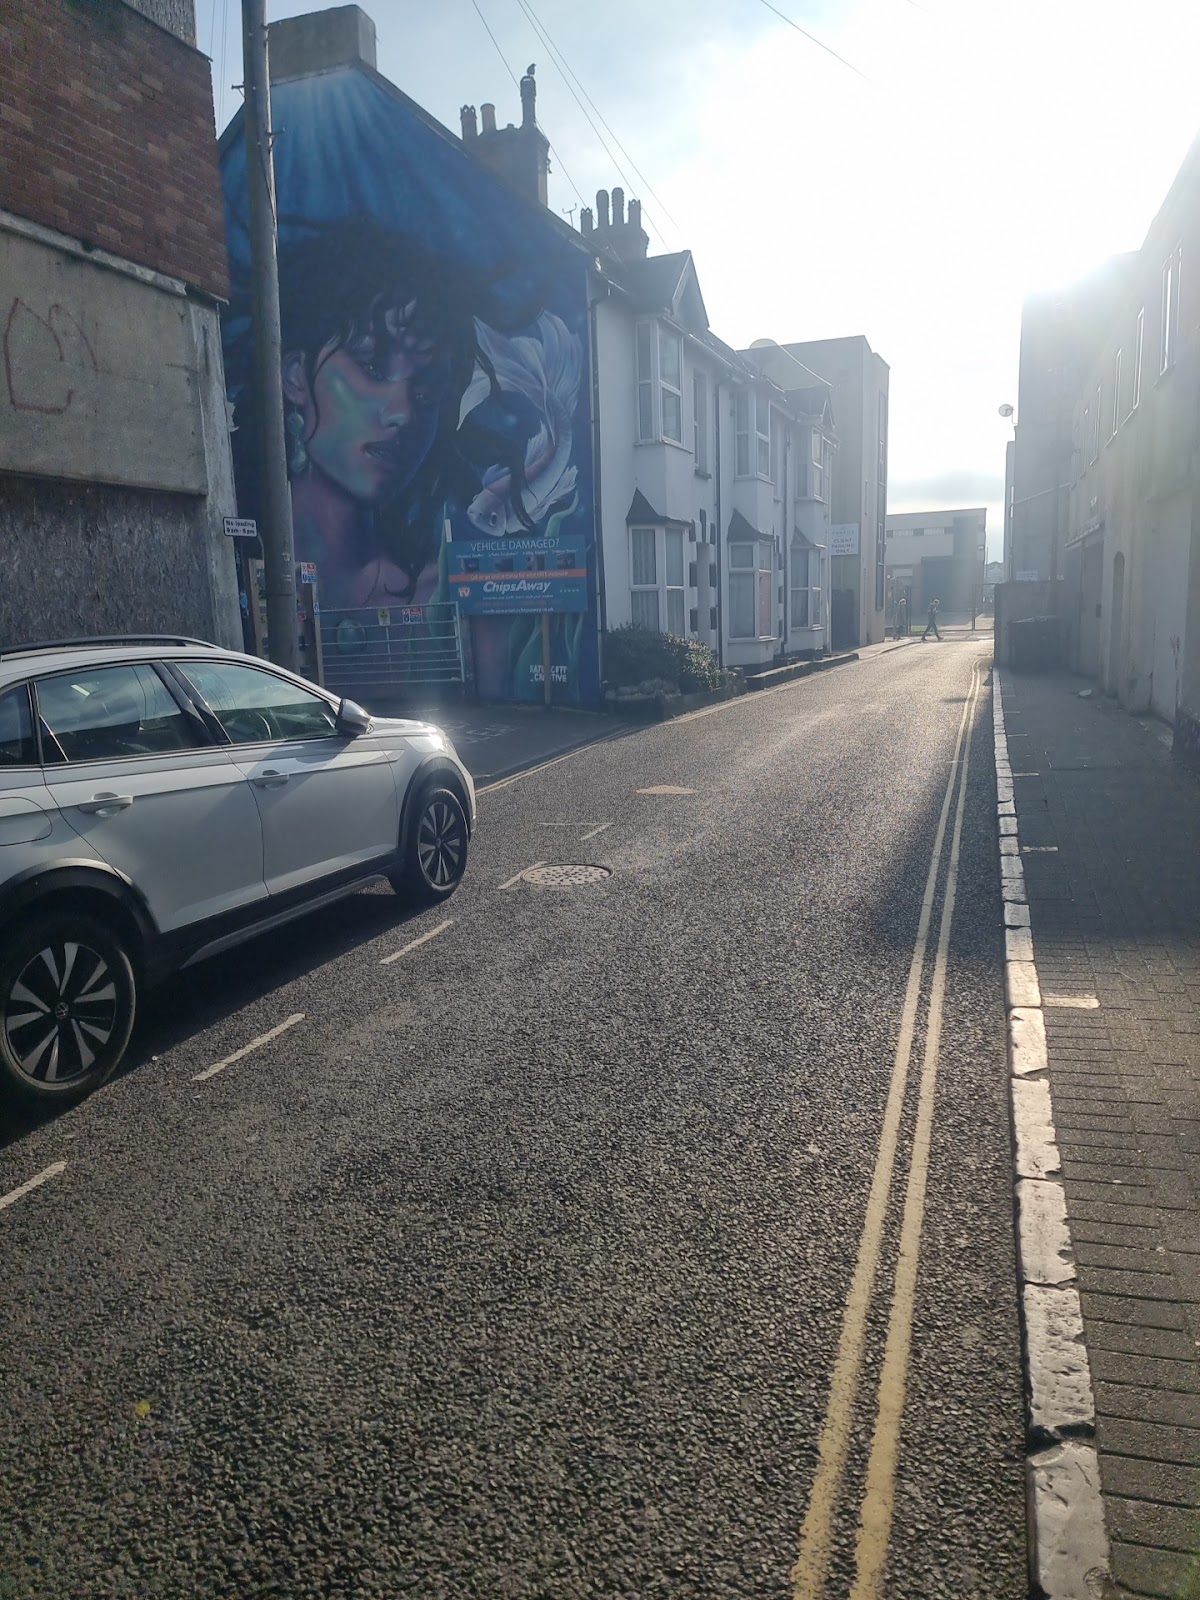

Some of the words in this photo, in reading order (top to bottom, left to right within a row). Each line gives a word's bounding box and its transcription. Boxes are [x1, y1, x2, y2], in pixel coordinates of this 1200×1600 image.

[470, 541, 507, 552] VEHICLE
[508, 538, 560, 550] DAMAGED?
[482, 579, 551, 594] ChipsAway
